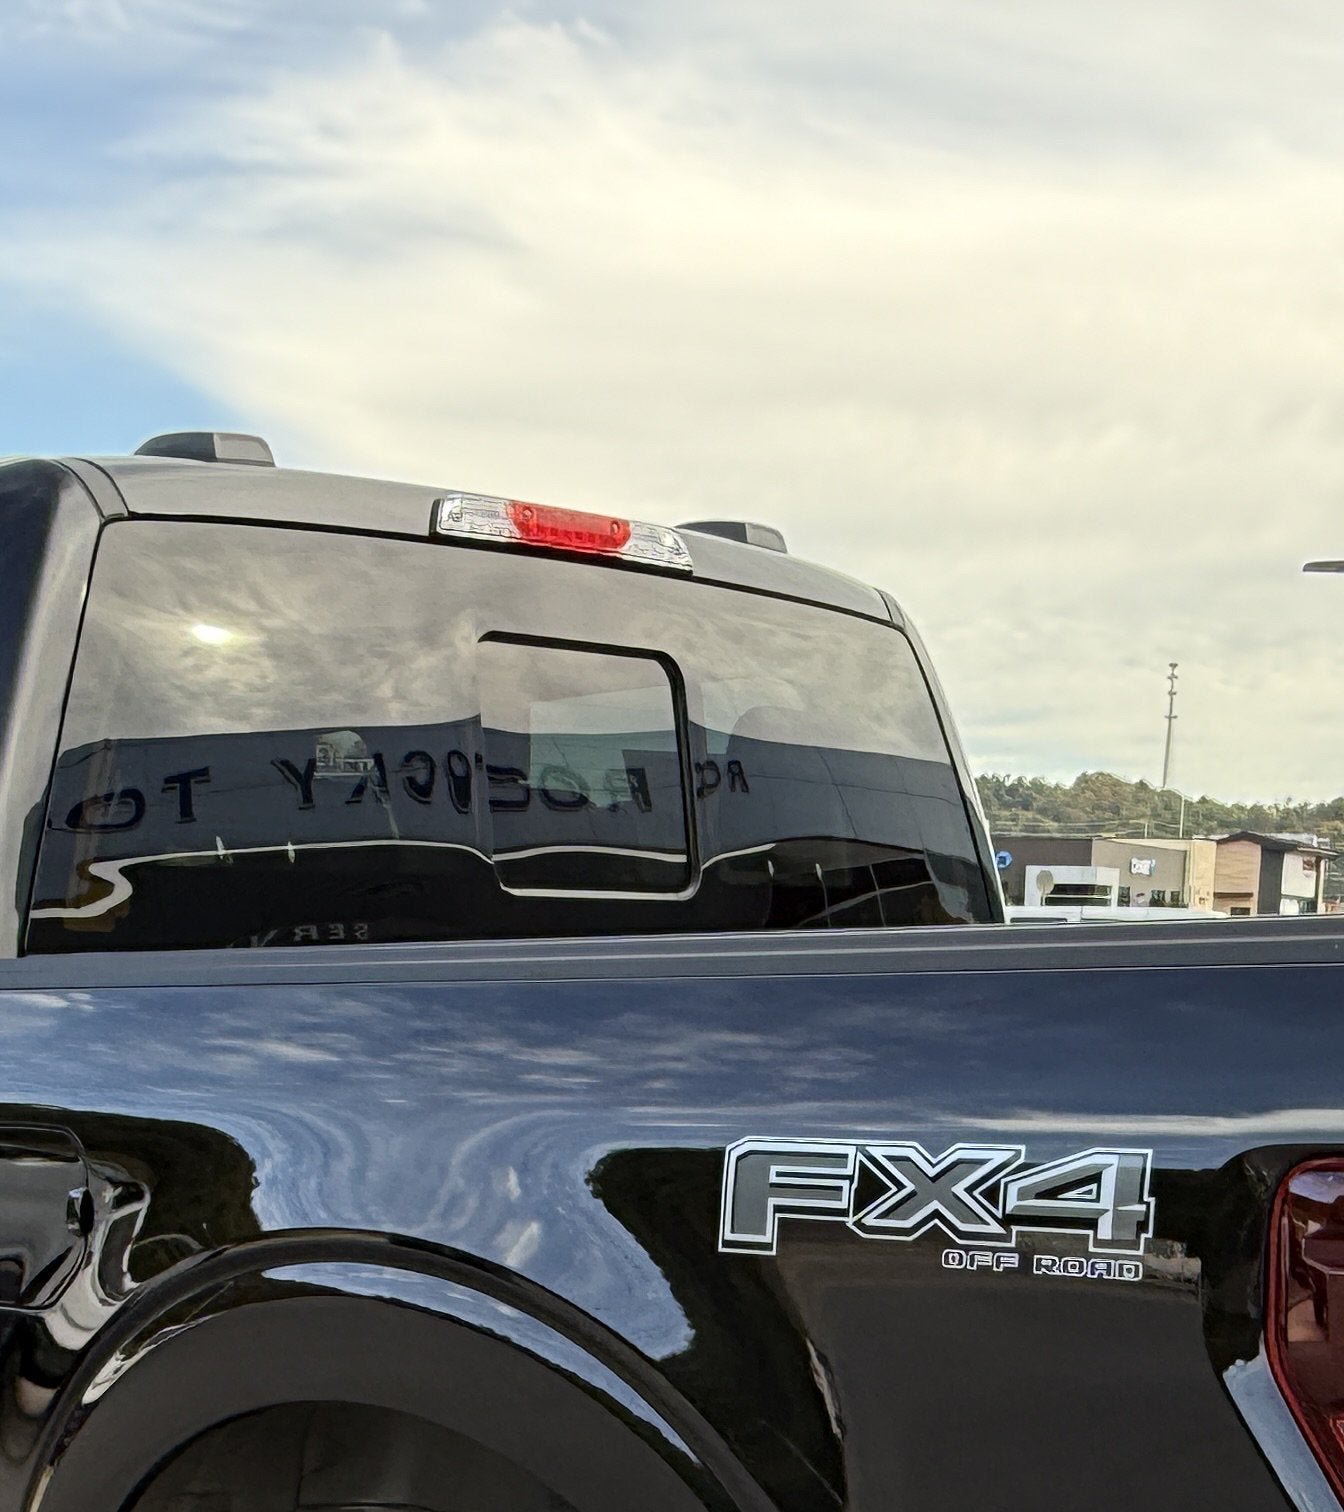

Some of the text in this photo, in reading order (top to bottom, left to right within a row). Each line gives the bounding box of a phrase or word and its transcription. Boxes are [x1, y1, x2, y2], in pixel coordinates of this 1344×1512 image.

[718, 1136, 1156, 1256] FX4
[942, 1248, 1144, 1281] OFF ROAD
